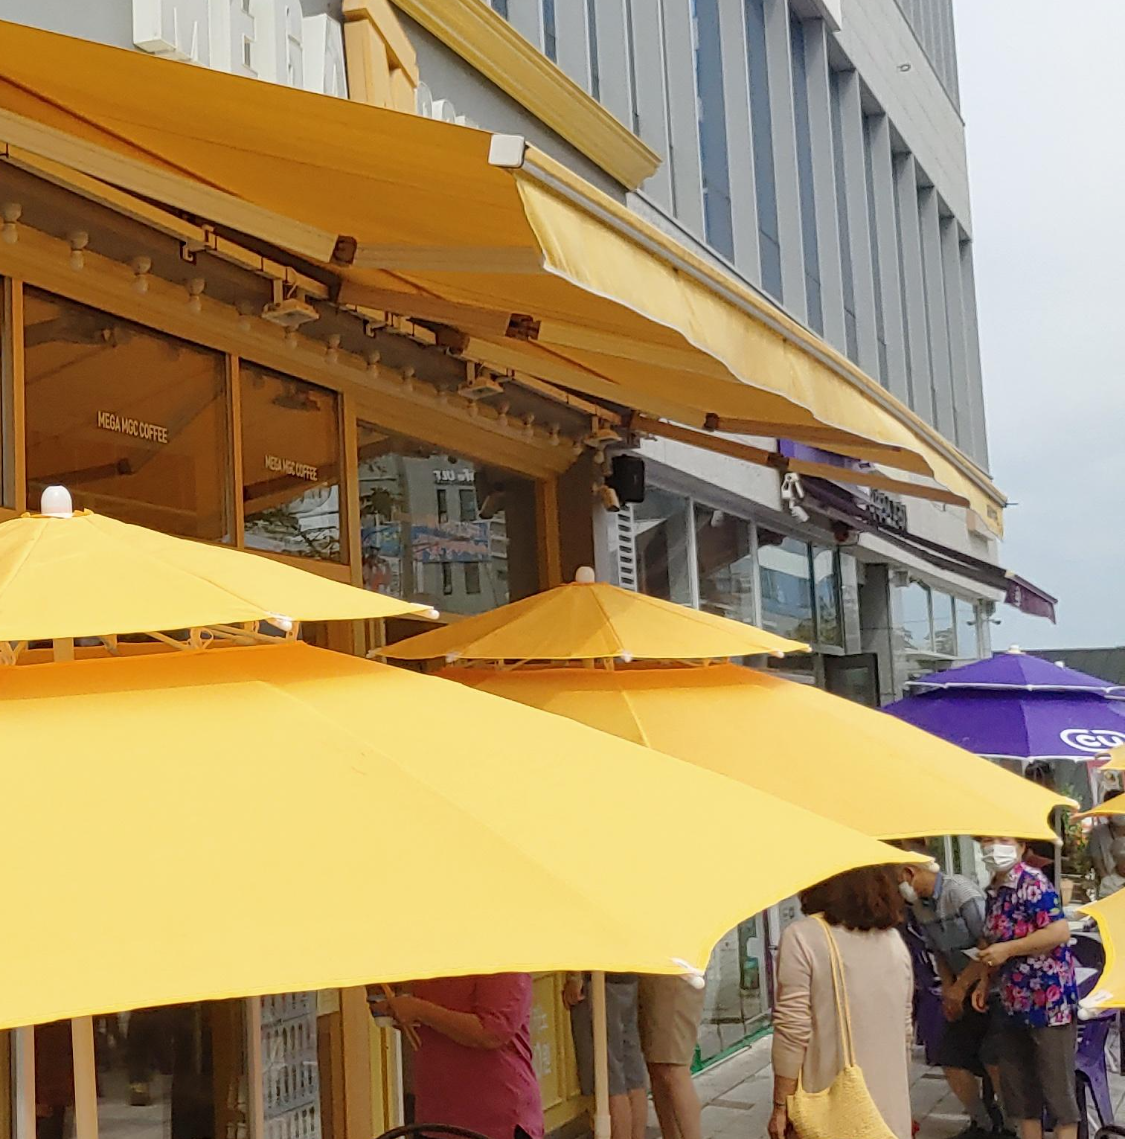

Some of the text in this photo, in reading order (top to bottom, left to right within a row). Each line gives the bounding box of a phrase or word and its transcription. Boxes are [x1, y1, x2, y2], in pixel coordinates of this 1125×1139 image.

[97, 410, 168, 444] MEGA MGC COFFEE
[296, 463, 318, 481] COFFEE
[1075, 734, 1124, 748] CU
